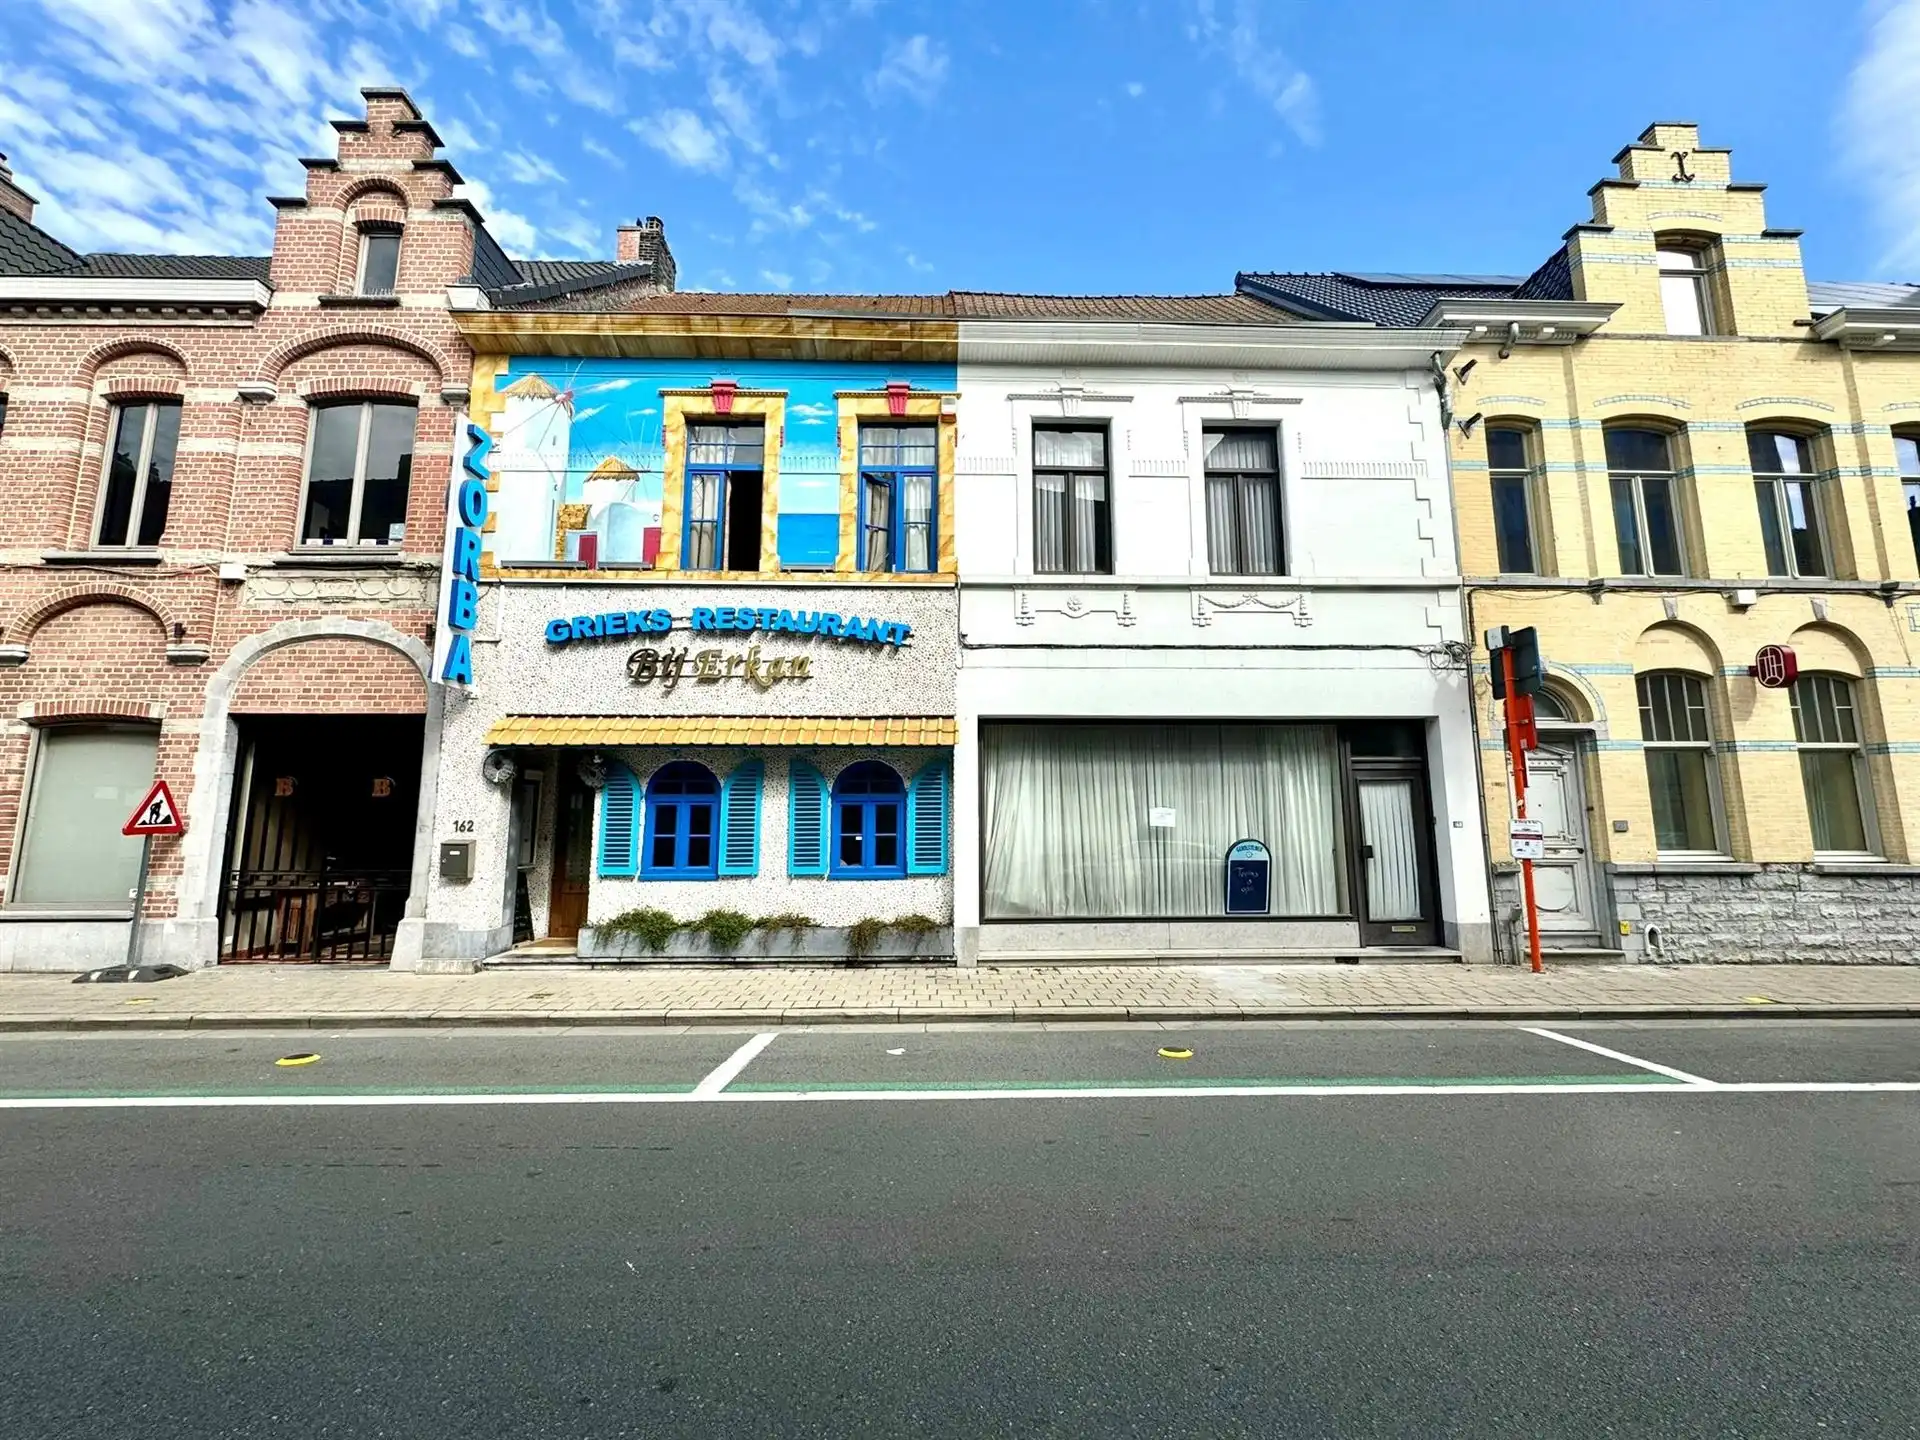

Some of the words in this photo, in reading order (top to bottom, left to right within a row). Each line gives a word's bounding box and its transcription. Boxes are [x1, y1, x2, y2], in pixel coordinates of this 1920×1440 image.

[442, 424, 493, 685] ZORBA
[544, 608, 673, 644] GRIEKS
[691, 607, 913, 645] RESTAURANT
[626, 647, 688, 688] Bij
[694, 645, 812, 687] Erkan
[452, 819, 474, 833] 162
